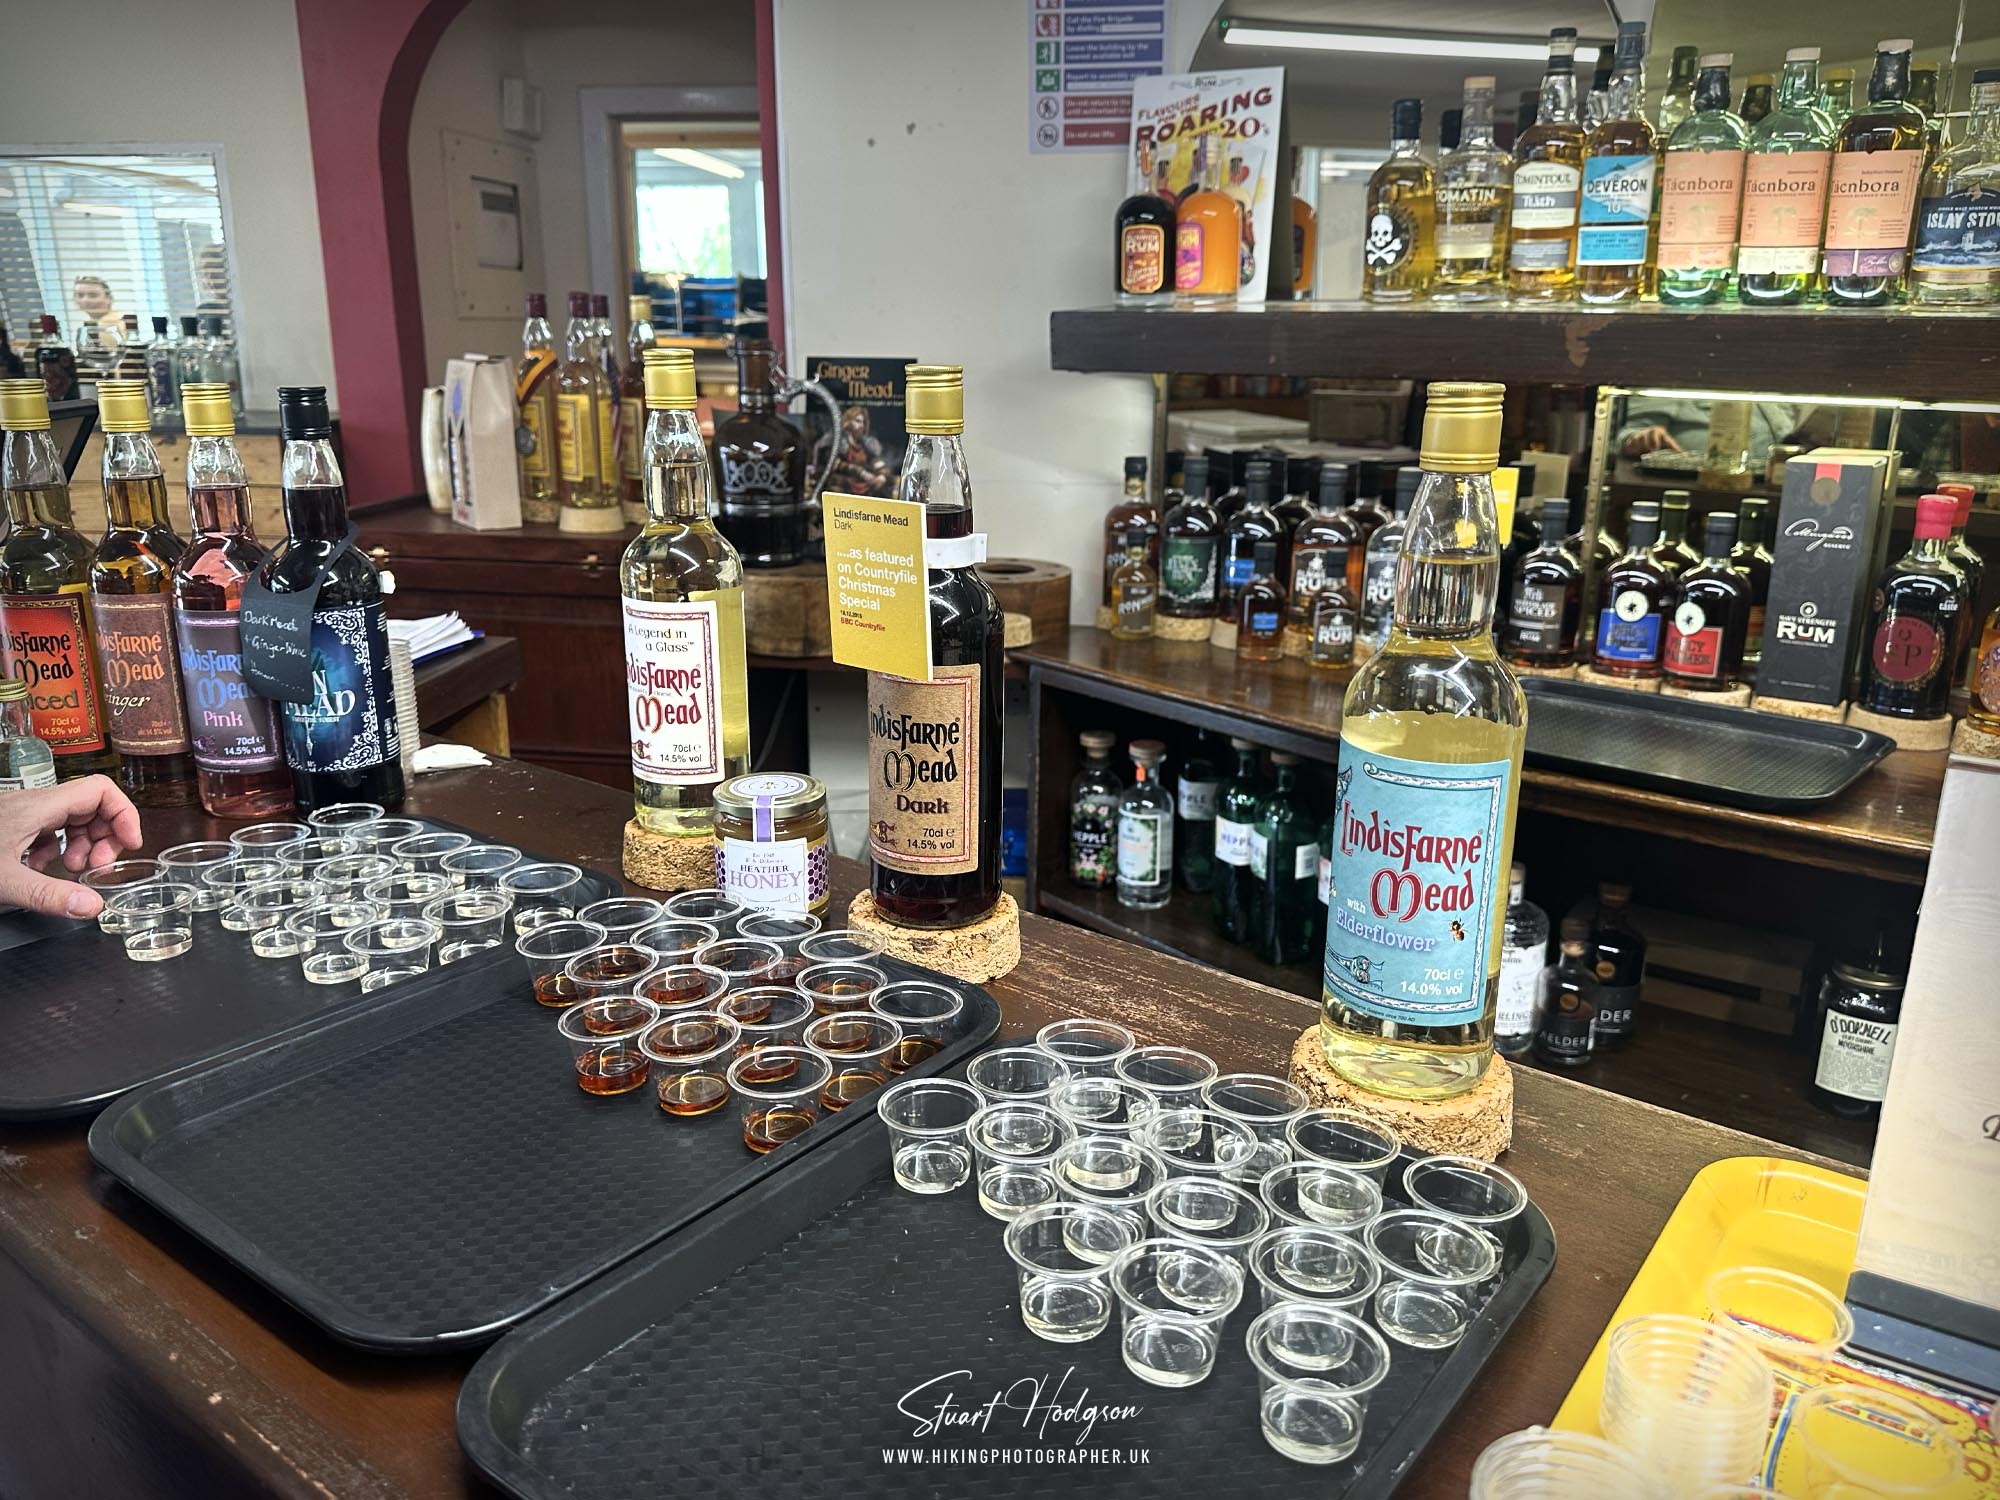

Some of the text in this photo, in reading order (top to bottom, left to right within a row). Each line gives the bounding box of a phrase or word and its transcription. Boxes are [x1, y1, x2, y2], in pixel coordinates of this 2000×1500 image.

[1137, 87, 1272, 142] ROARING
[1587, 178, 1648, 193] DEVERON
[1435, 188, 1495, 203] TOMATIN
[1927, 212, 1965, 229] ISLAY
[833, 507, 909, 527] Lindisfarne Mead
[834, 520, 853, 532] Dark
[865, 547, 915, 569] featured
[837, 562, 918, 585] on Countryfile
[838, 575, 896, 599] Christmas
[839, 591, 881, 612] Special
[634, 625, 671, 640] Legend
[675, 629, 687, 639] in
[1776, 620, 1836, 644] RUM
[645, 642, 653, 651] a
[13, 653, 75, 690] Mead
[106, 654, 166, 689] Mead
[29, 688, 79, 712] iced
[104, 683, 151, 717] inger
[50, 717, 70, 727] 70cl
[203, 710, 244, 727] Pink
[636, 693, 702, 734] Mead
[40, 726, 81, 737] 14.5% vol
[236, 736, 255, 746] 70cl
[673, 744, 692, 753] 70cl
[224, 744, 266, 756] 14.5% vol
[660, 754, 702, 764] 14.5% vol
[884, 748, 958, 792] Mead
[895, 793, 950, 815] Dark
[922, 827, 944, 839] 70cl
[906, 838, 955, 850] 14.5% vol
[740, 864, 789, 874] HEATHER
[730, 870, 804, 890] HONEY
[1369, 868, 1475, 923] Mead
[1346, 898, 1367, 915] with
[1335, 906, 1436, 953] Elderflower
[1424, 968, 1451, 981] 70cl
[1400, 980, 1463, 996] 14.0% vol
[1830, 1016, 1891, 1046] O'DONNELL
